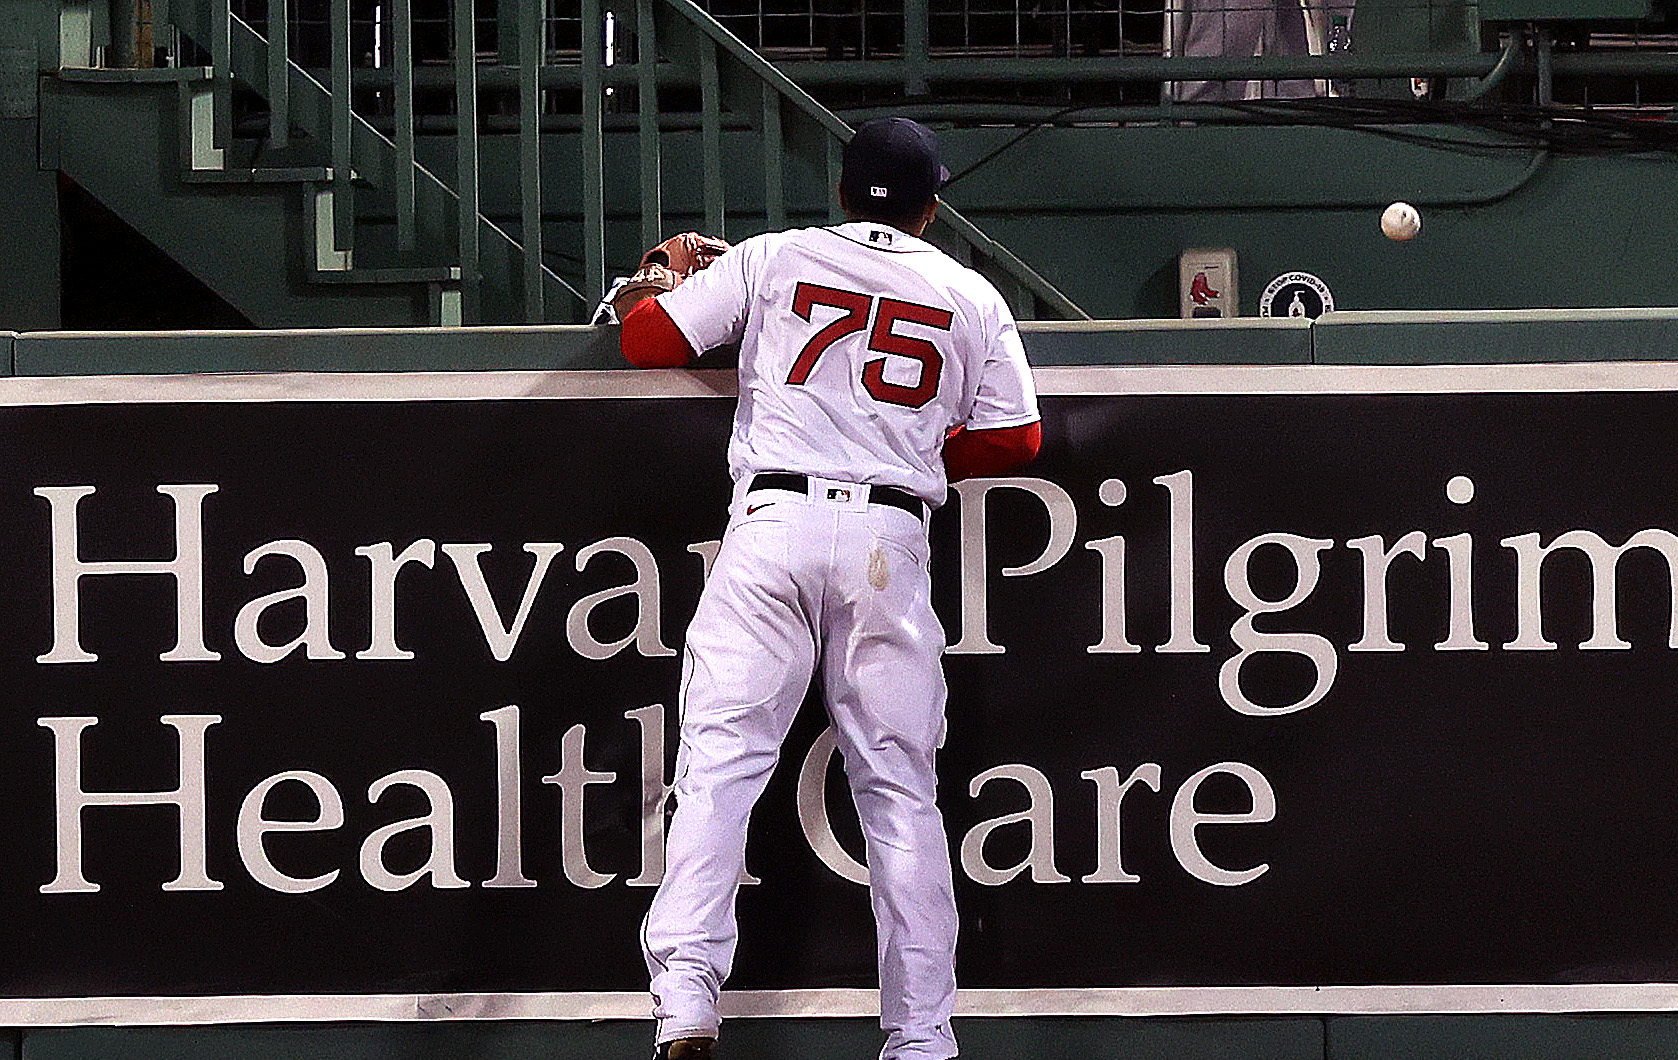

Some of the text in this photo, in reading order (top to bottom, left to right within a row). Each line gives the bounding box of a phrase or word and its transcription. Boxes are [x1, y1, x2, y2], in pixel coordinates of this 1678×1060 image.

[784, 280, 955, 410] 75
[1289, 274, 1326, 293] COVID-19
[33, 484, 721, 663] Harva
